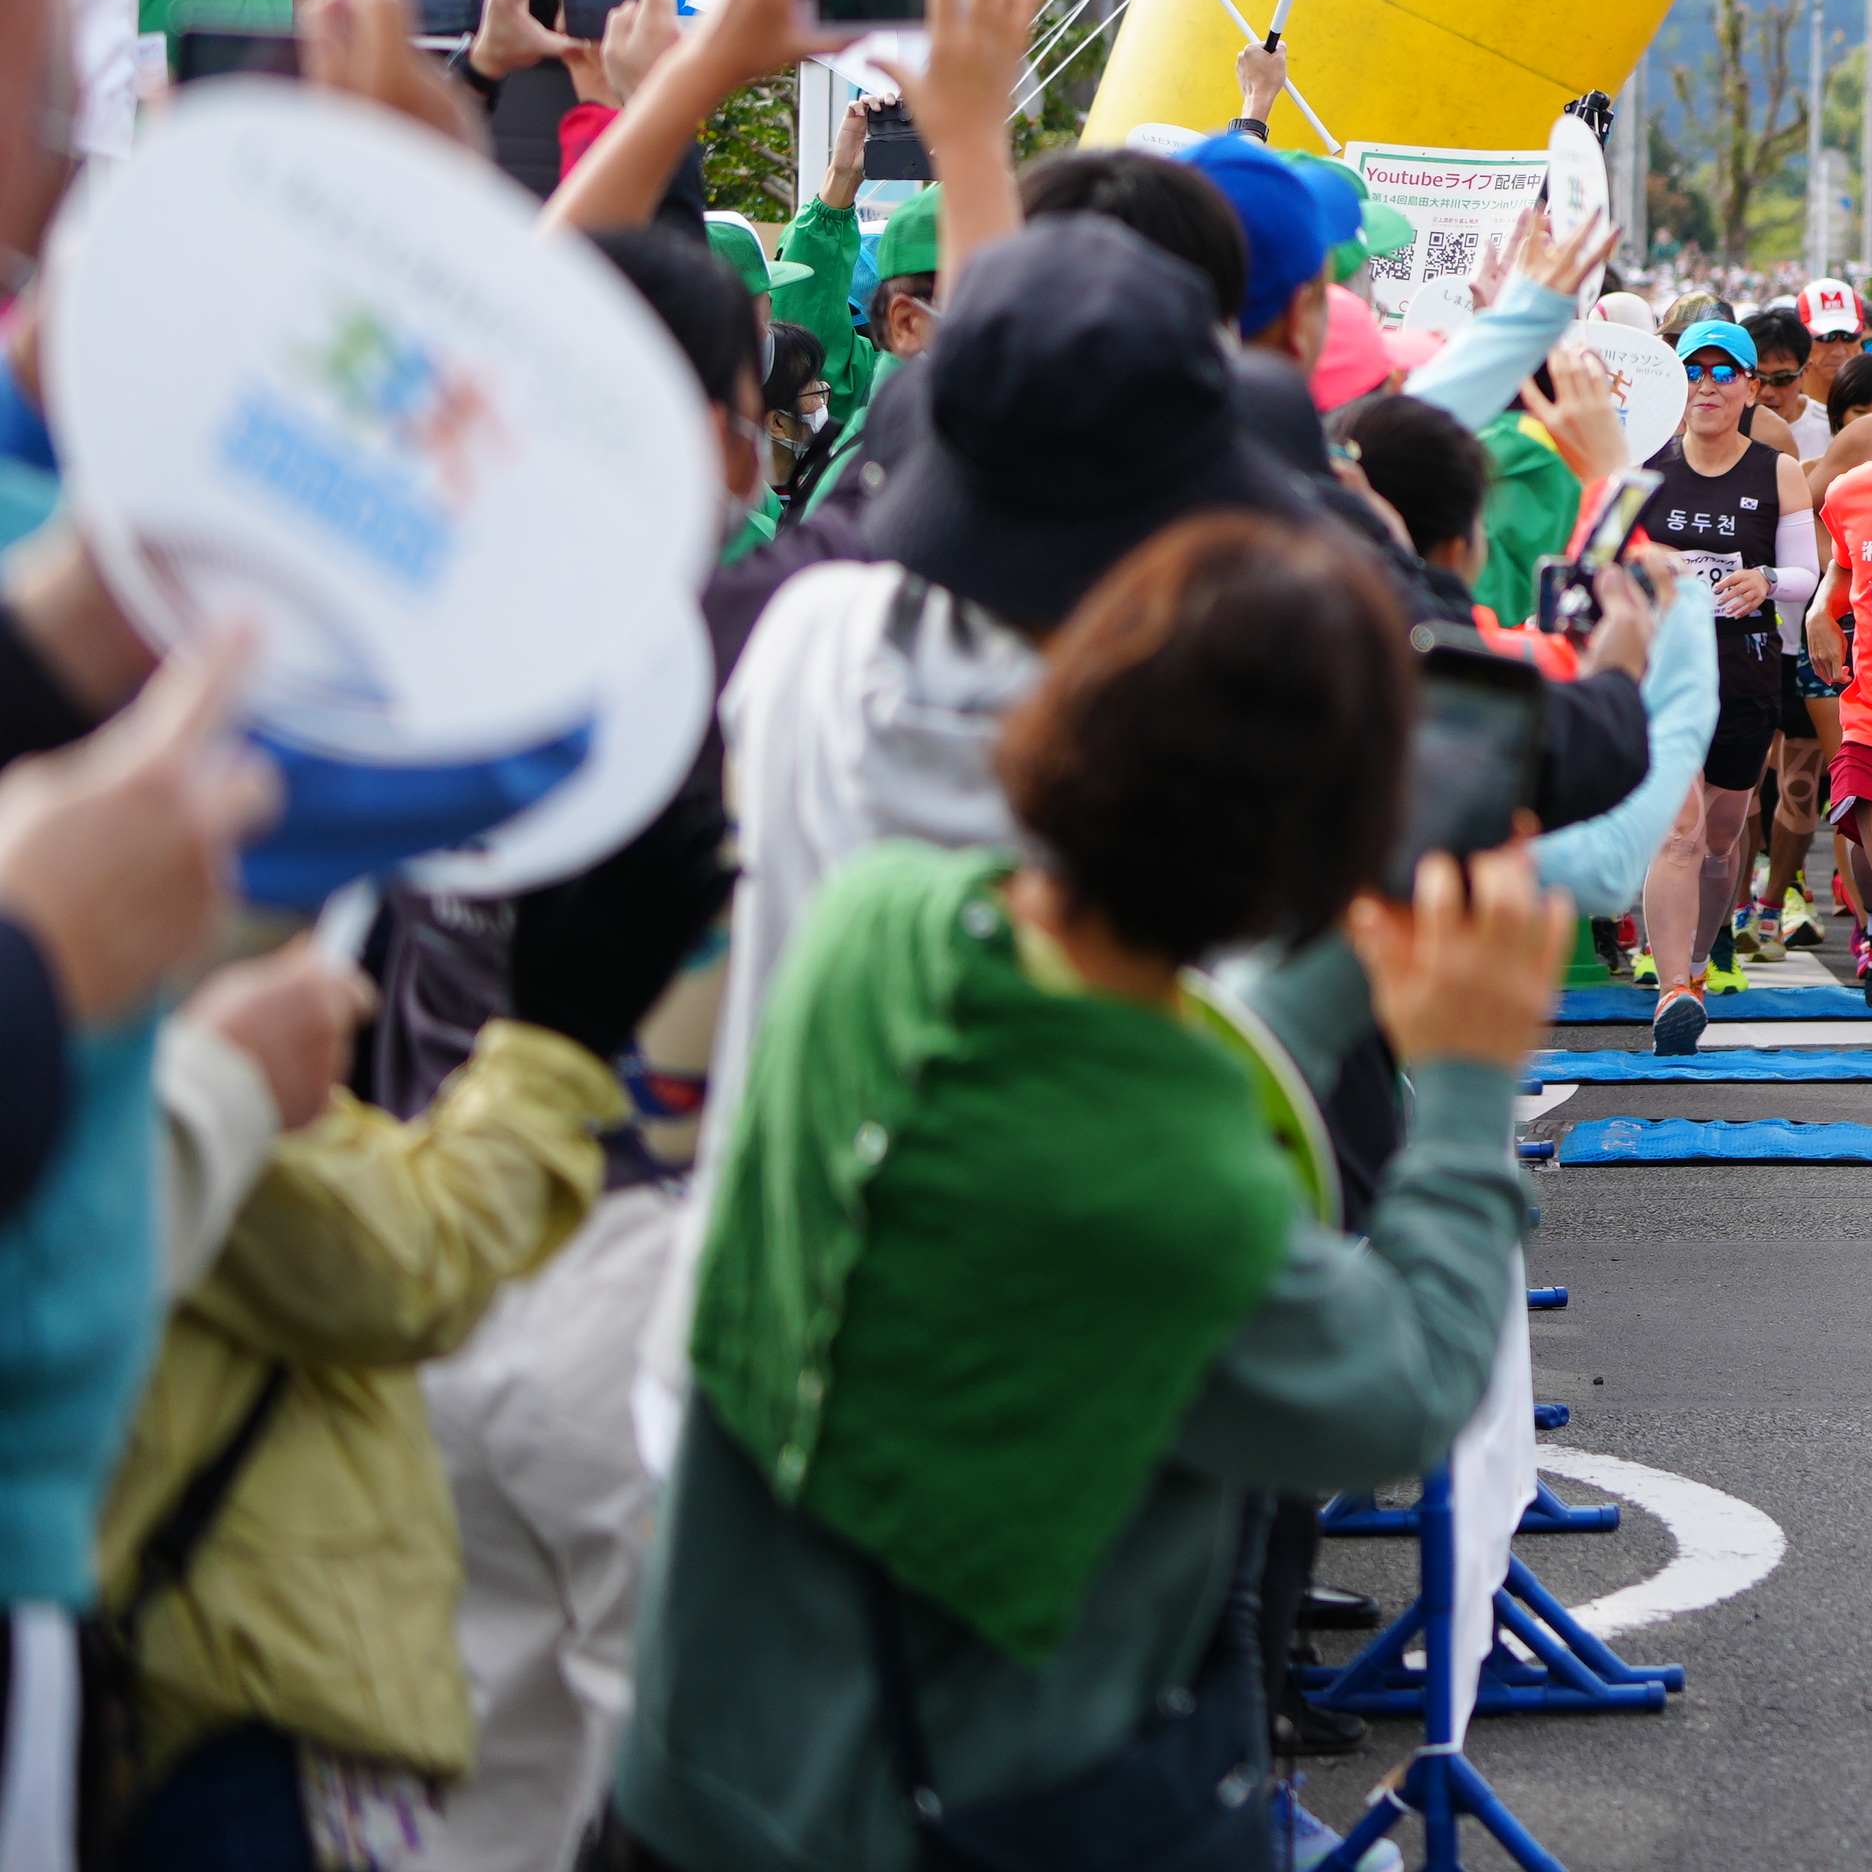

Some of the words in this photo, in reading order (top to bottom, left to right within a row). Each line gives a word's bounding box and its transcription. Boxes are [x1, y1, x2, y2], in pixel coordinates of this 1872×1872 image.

[1366, 166, 1541, 191] Youtubeライブ配信中
[1666, 509, 1736, 536] 동두천
